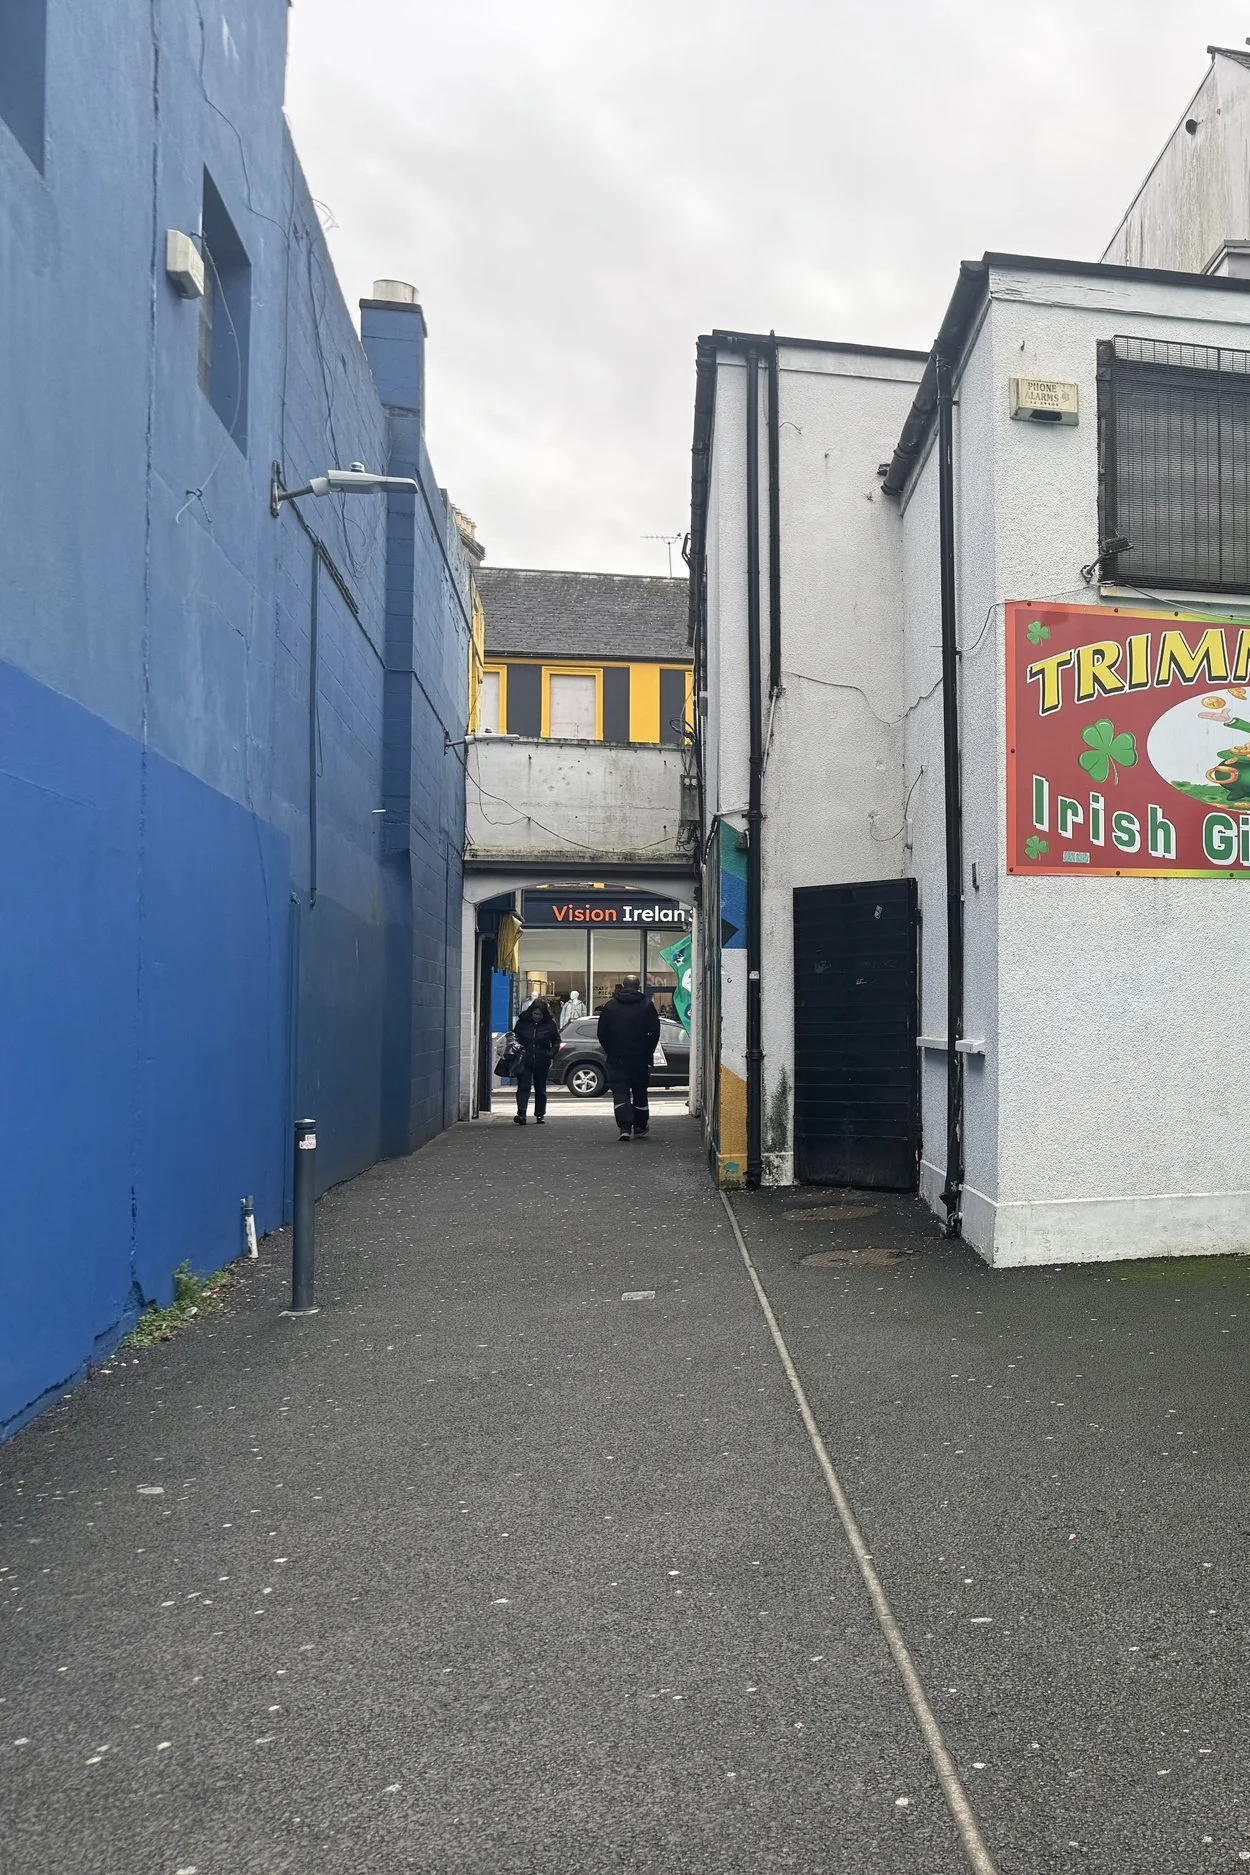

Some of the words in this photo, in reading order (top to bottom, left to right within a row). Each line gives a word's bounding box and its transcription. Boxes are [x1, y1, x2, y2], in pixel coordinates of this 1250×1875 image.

[1028, 382, 1057, 393] PHONE
[1024, 391, 1059, 402] ALARMS
[1032, 774, 1176, 860] Irish
[552, 904, 617, 922] Vision
